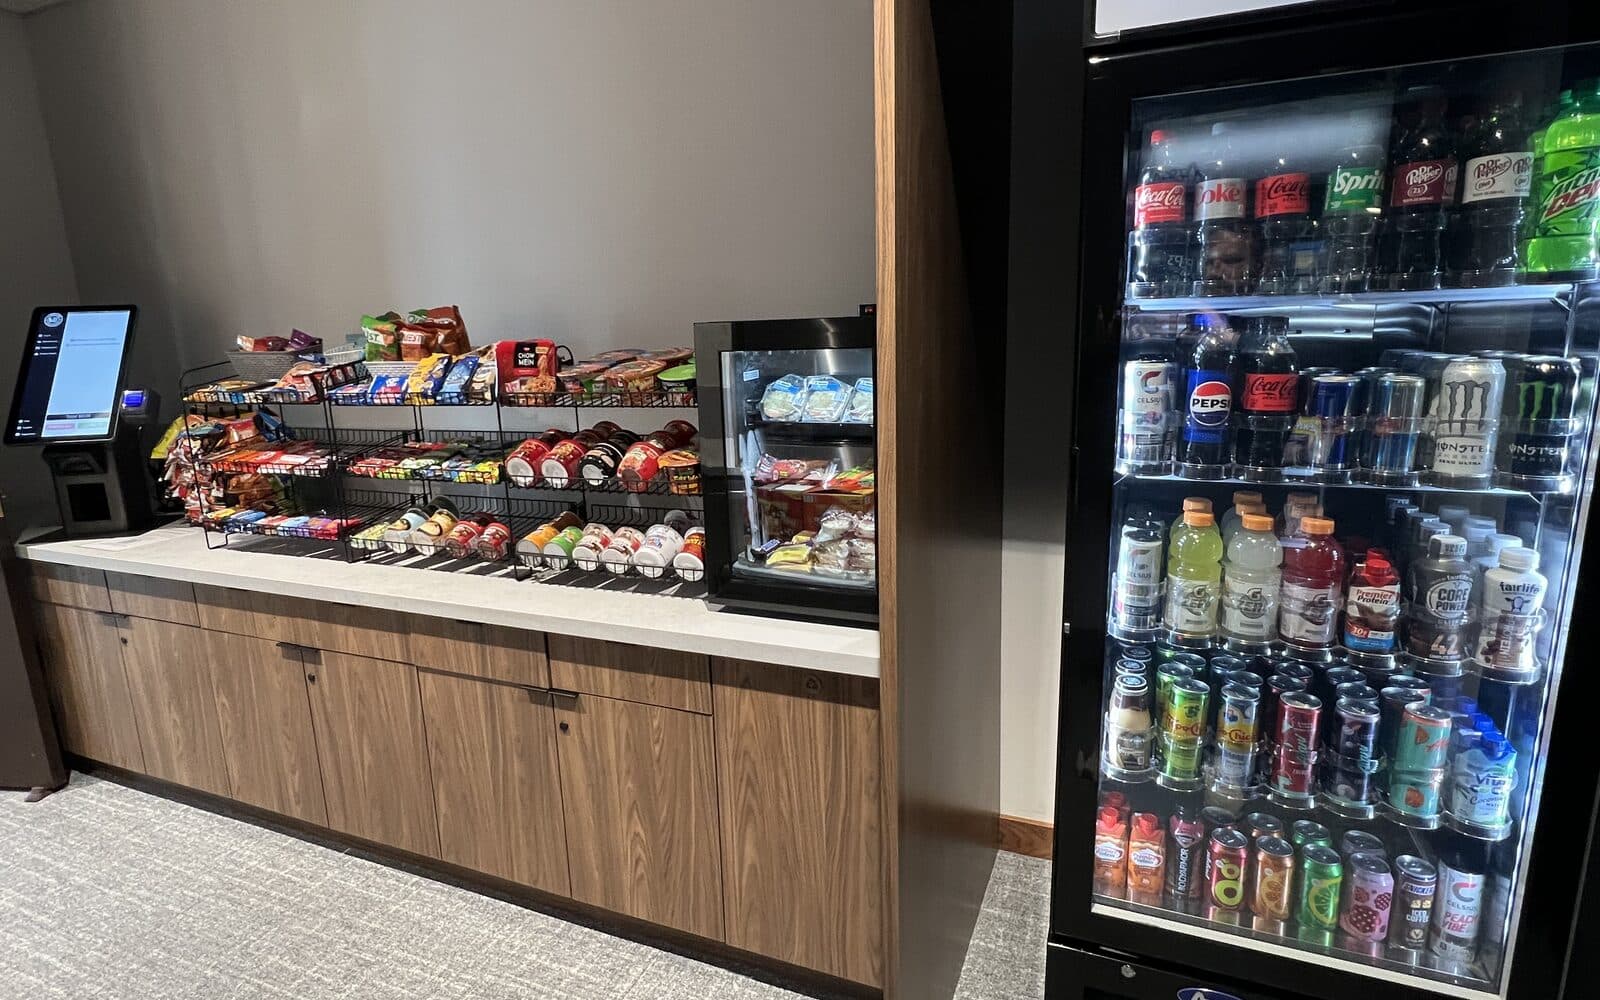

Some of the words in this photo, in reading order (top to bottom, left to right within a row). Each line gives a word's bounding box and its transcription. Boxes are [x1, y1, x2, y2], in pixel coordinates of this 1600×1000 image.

[1475, 160, 1510, 179] Pepper
[1406, 168, 1441, 186] Pepper
[1356, 588, 1394, 600] Premier
[1437, 588, 1469, 601] CORE
[1499, 582, 1541, 594] fairlife
[1356, 595, 1389, 606] Protein
[1442, 920, 1467, 933] VIBE
